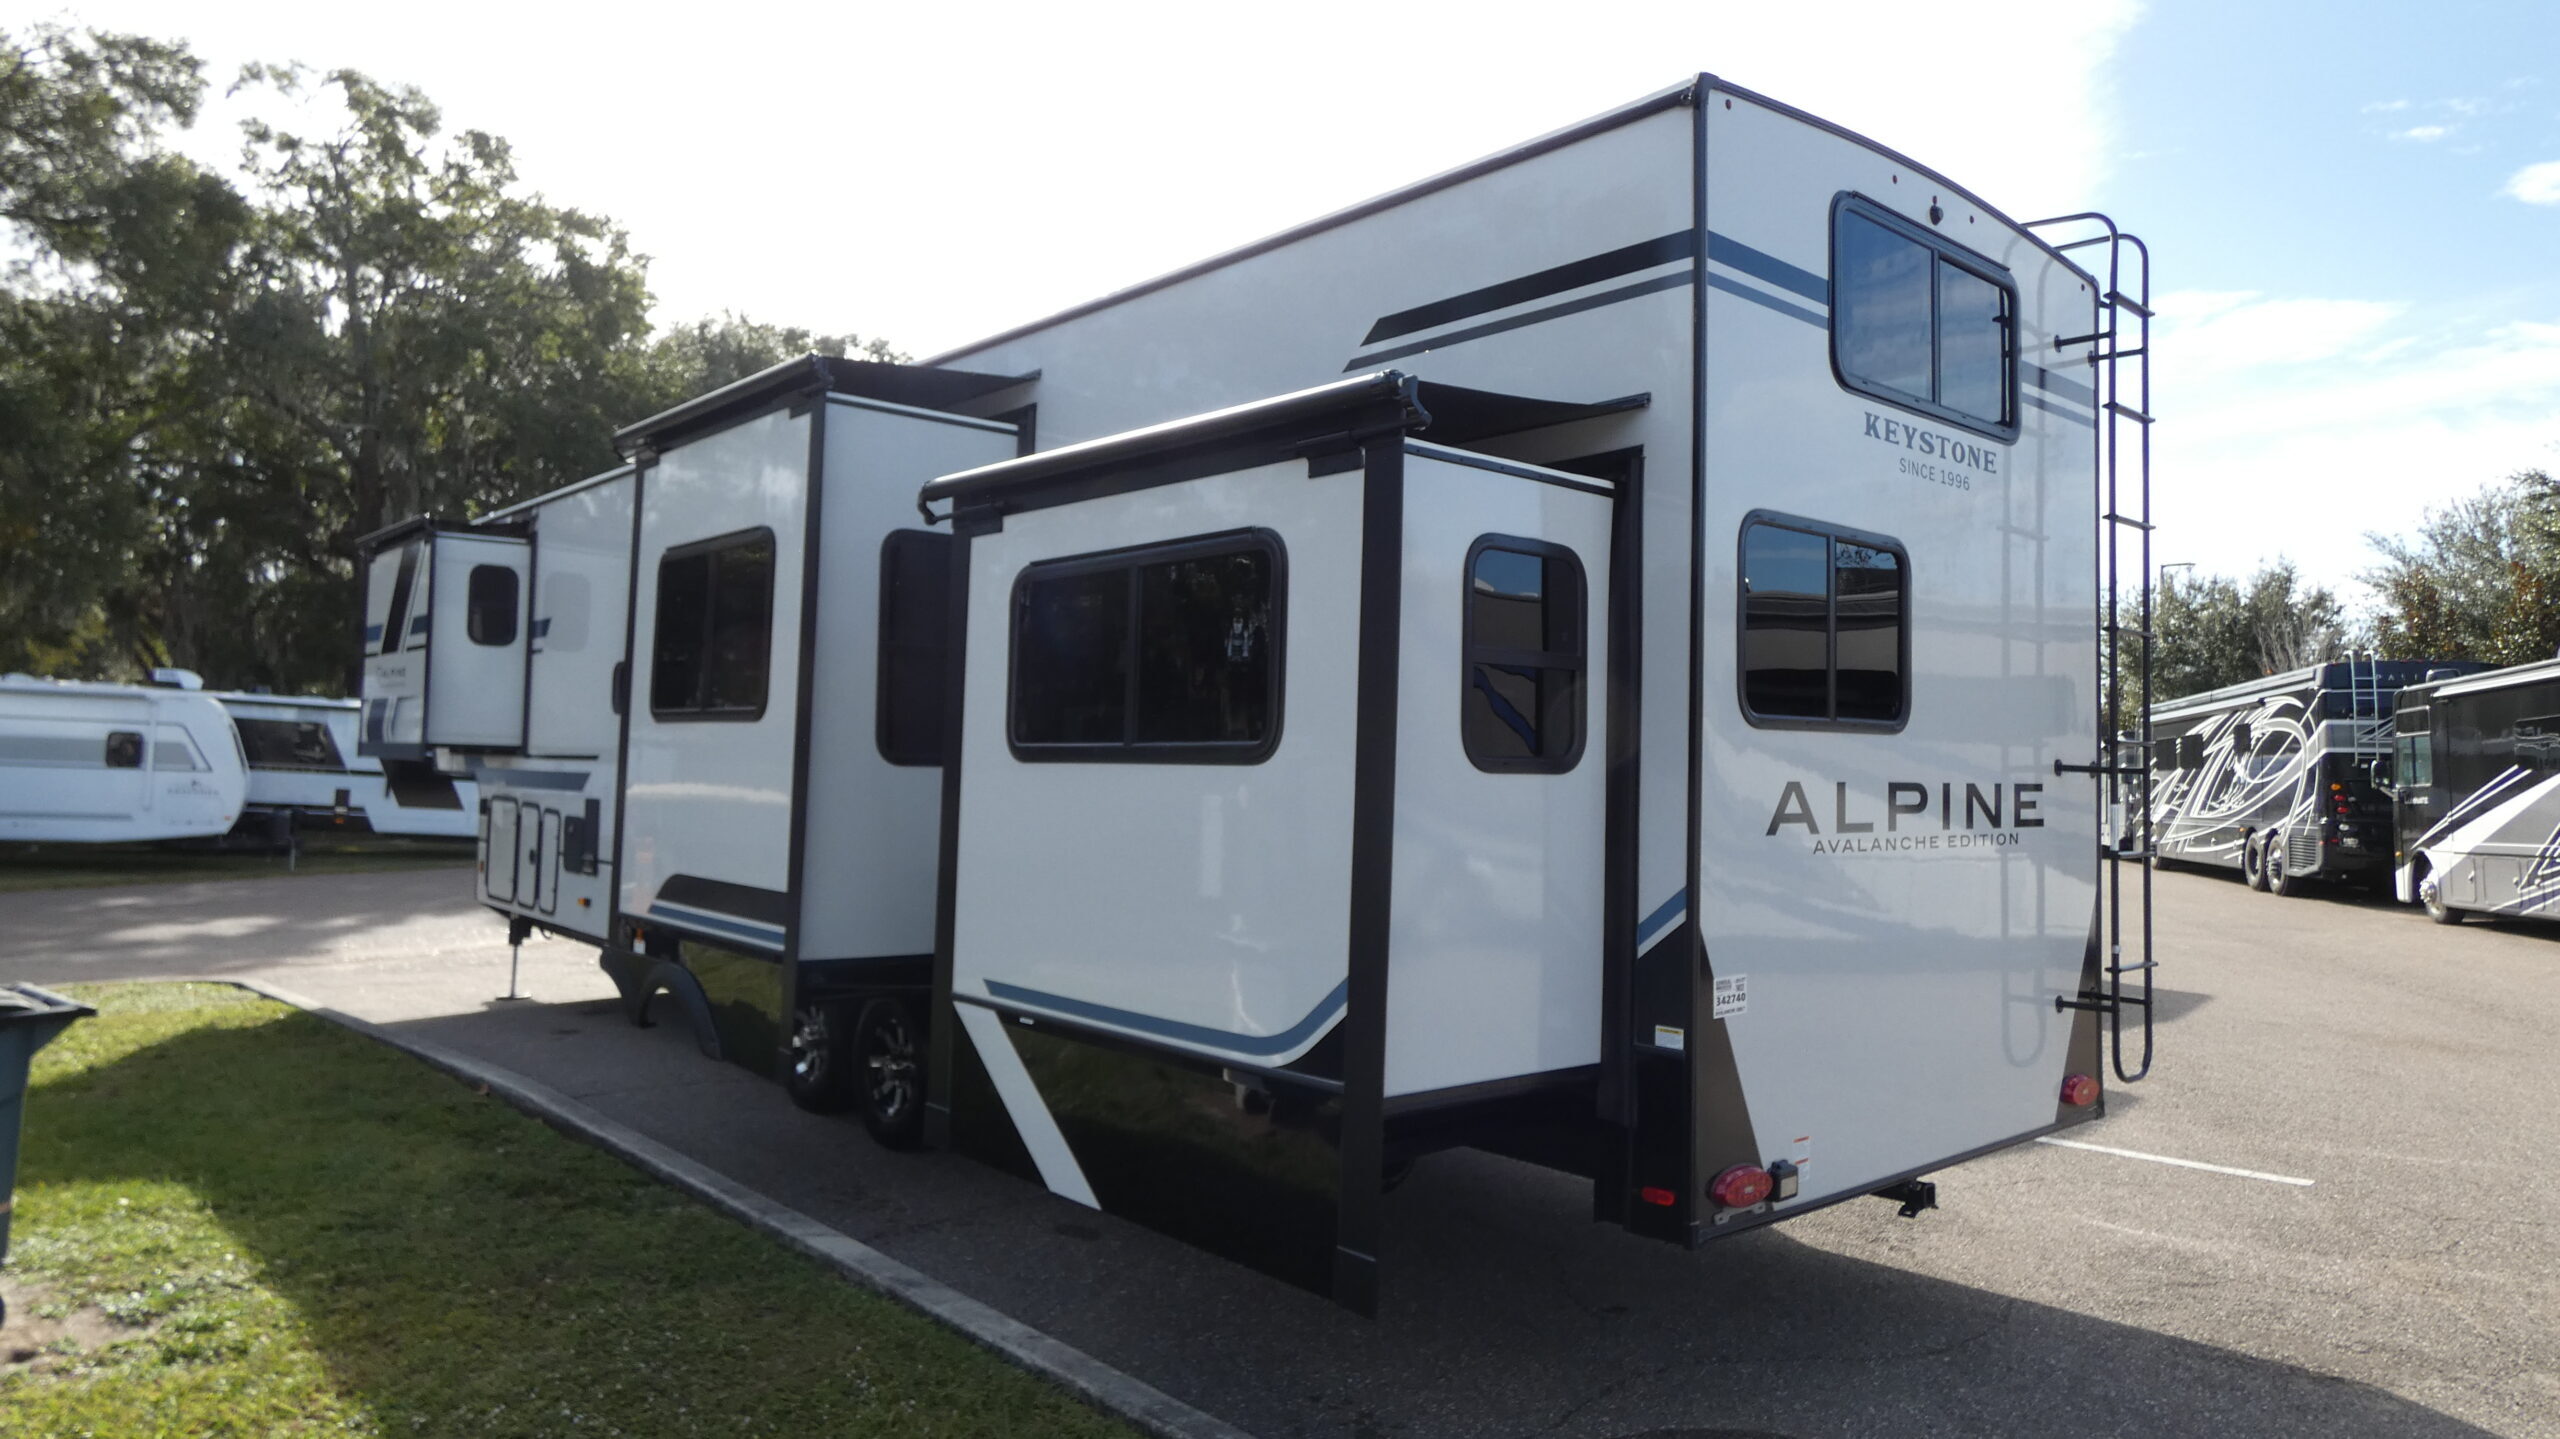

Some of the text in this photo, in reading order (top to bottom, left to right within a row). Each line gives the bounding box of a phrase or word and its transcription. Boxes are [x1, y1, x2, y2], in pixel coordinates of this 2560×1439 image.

[1864, 411, 1998, 475] KEYSTONE
[1899, 457, 1971, 492] SINCE 1996
[1765, 781, 2045, 837] ALPINE
[1813, 832, 2020, 855] AVALANCHE EDITION
